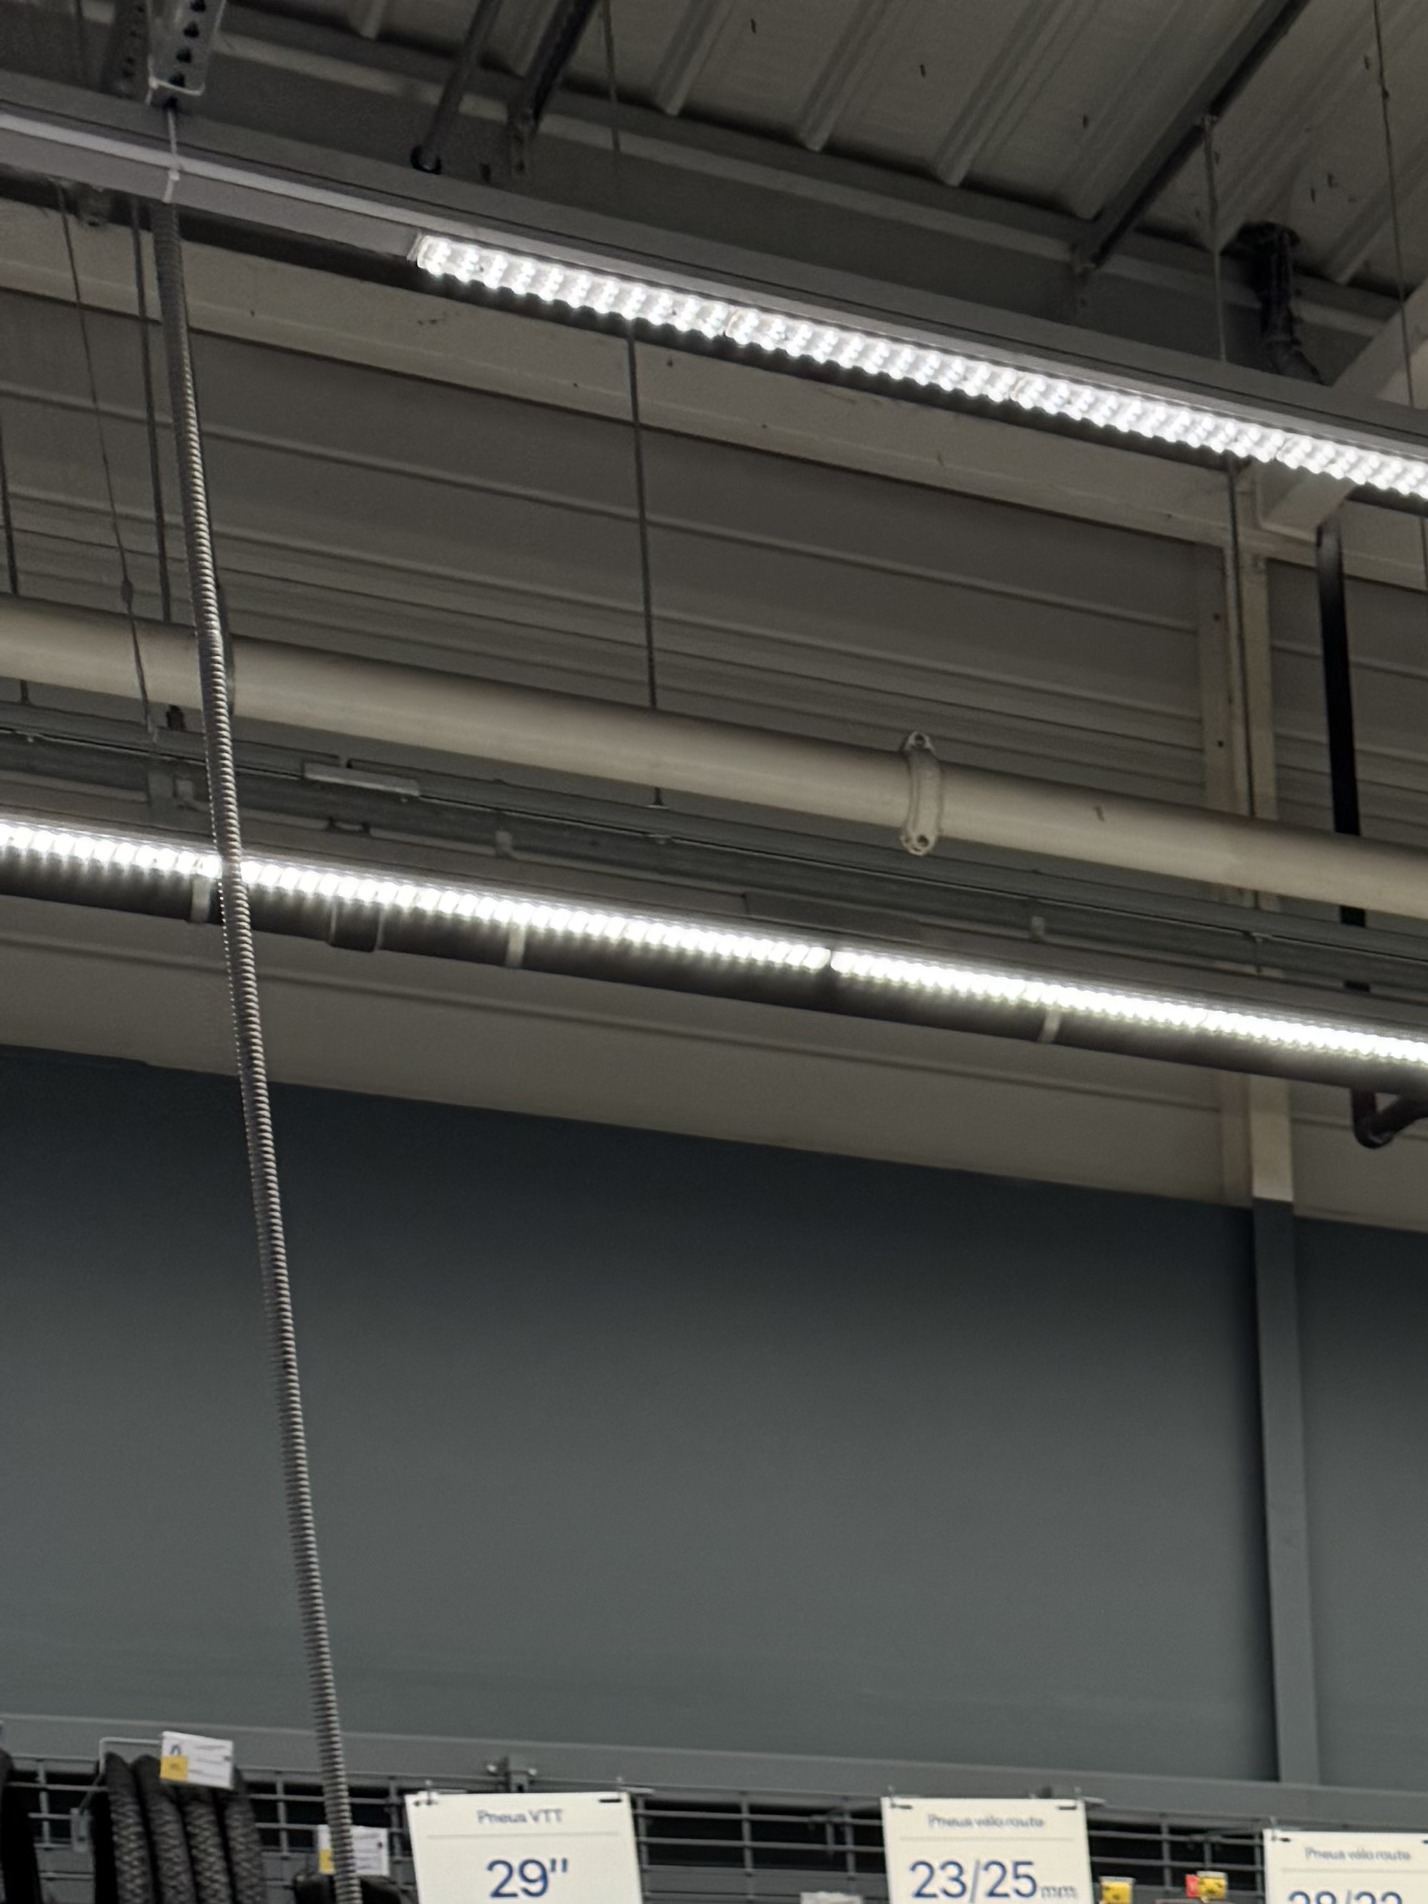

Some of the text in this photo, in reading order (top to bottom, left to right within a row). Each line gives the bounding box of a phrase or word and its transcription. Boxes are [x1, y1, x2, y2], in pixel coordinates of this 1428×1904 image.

[477, 1809, 564, 1823] Pneus VTT
[928, 1814, 974, 1828] Pneus
[1002, 1816, 1045, 1828] route
[1305, 1847, 1346, 1860] Pneus
[1376, 1850, 1412, 1861] route
